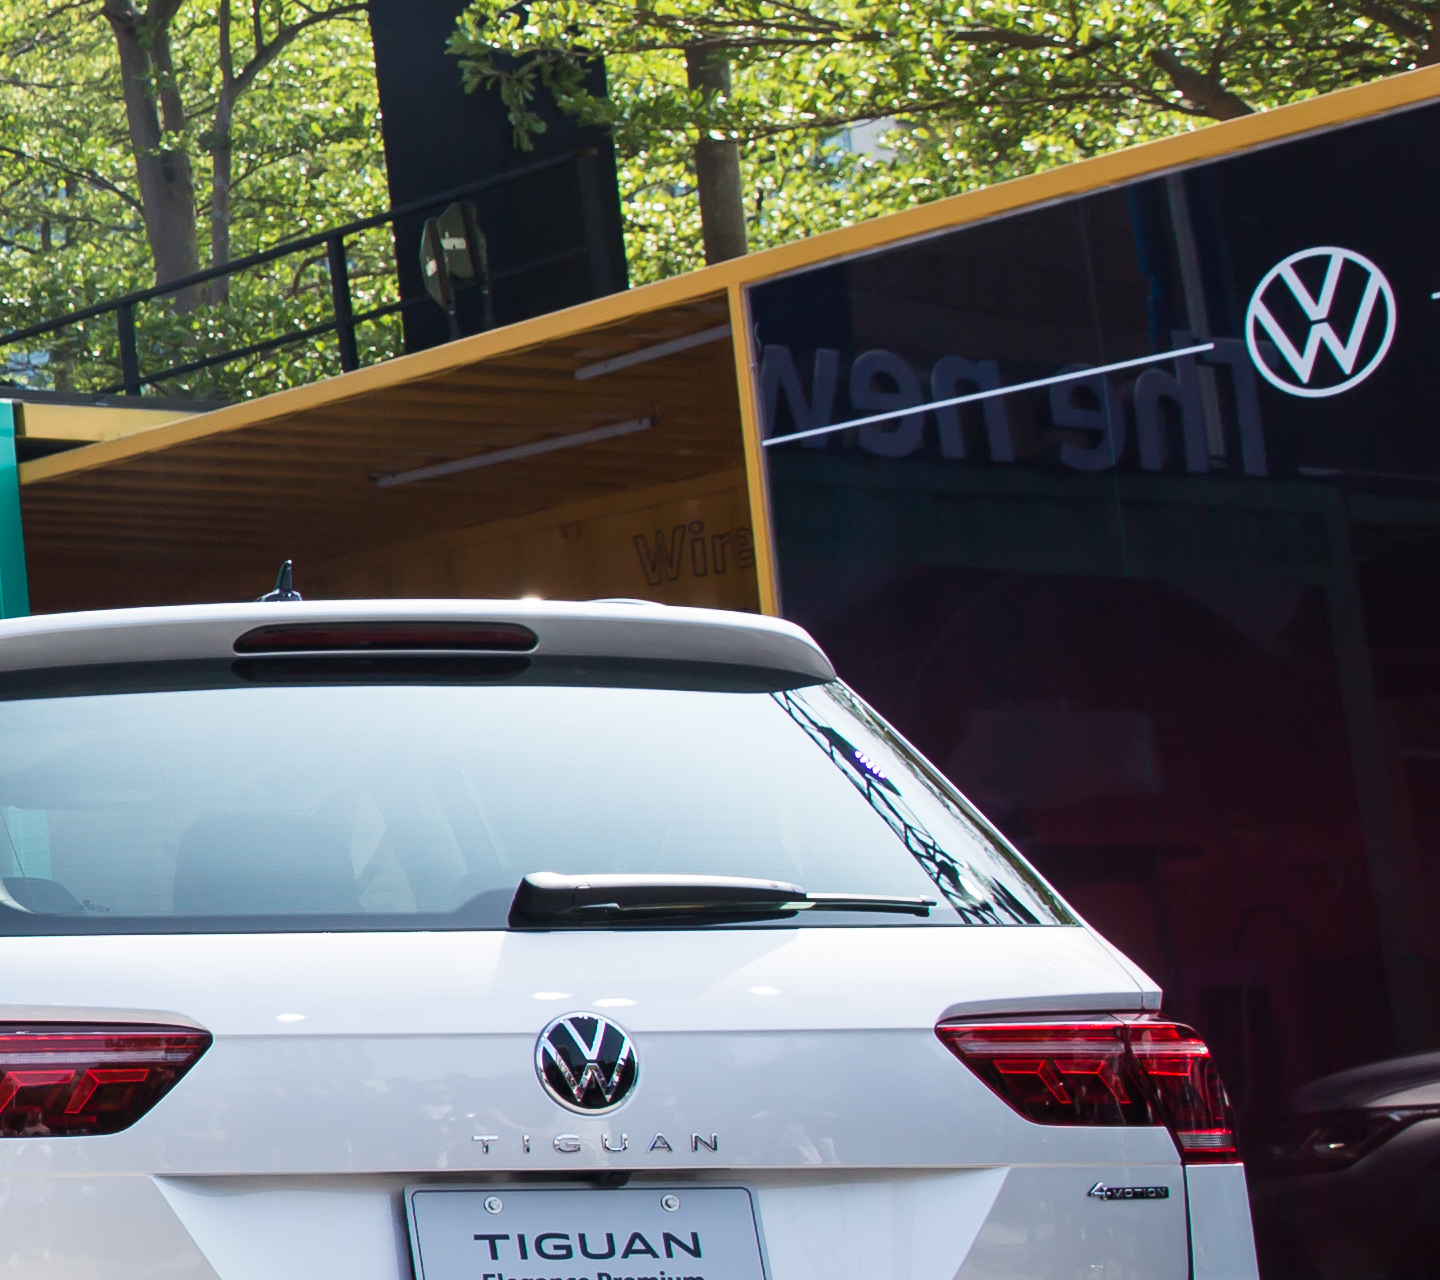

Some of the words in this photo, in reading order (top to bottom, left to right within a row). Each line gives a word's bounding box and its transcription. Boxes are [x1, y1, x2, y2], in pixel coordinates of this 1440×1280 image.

[1245, 246, 1397, 398] VW
[472, 1132, 719, 1155] TIGUAN
[473, 1231, 702, 1261] TIGUAN
